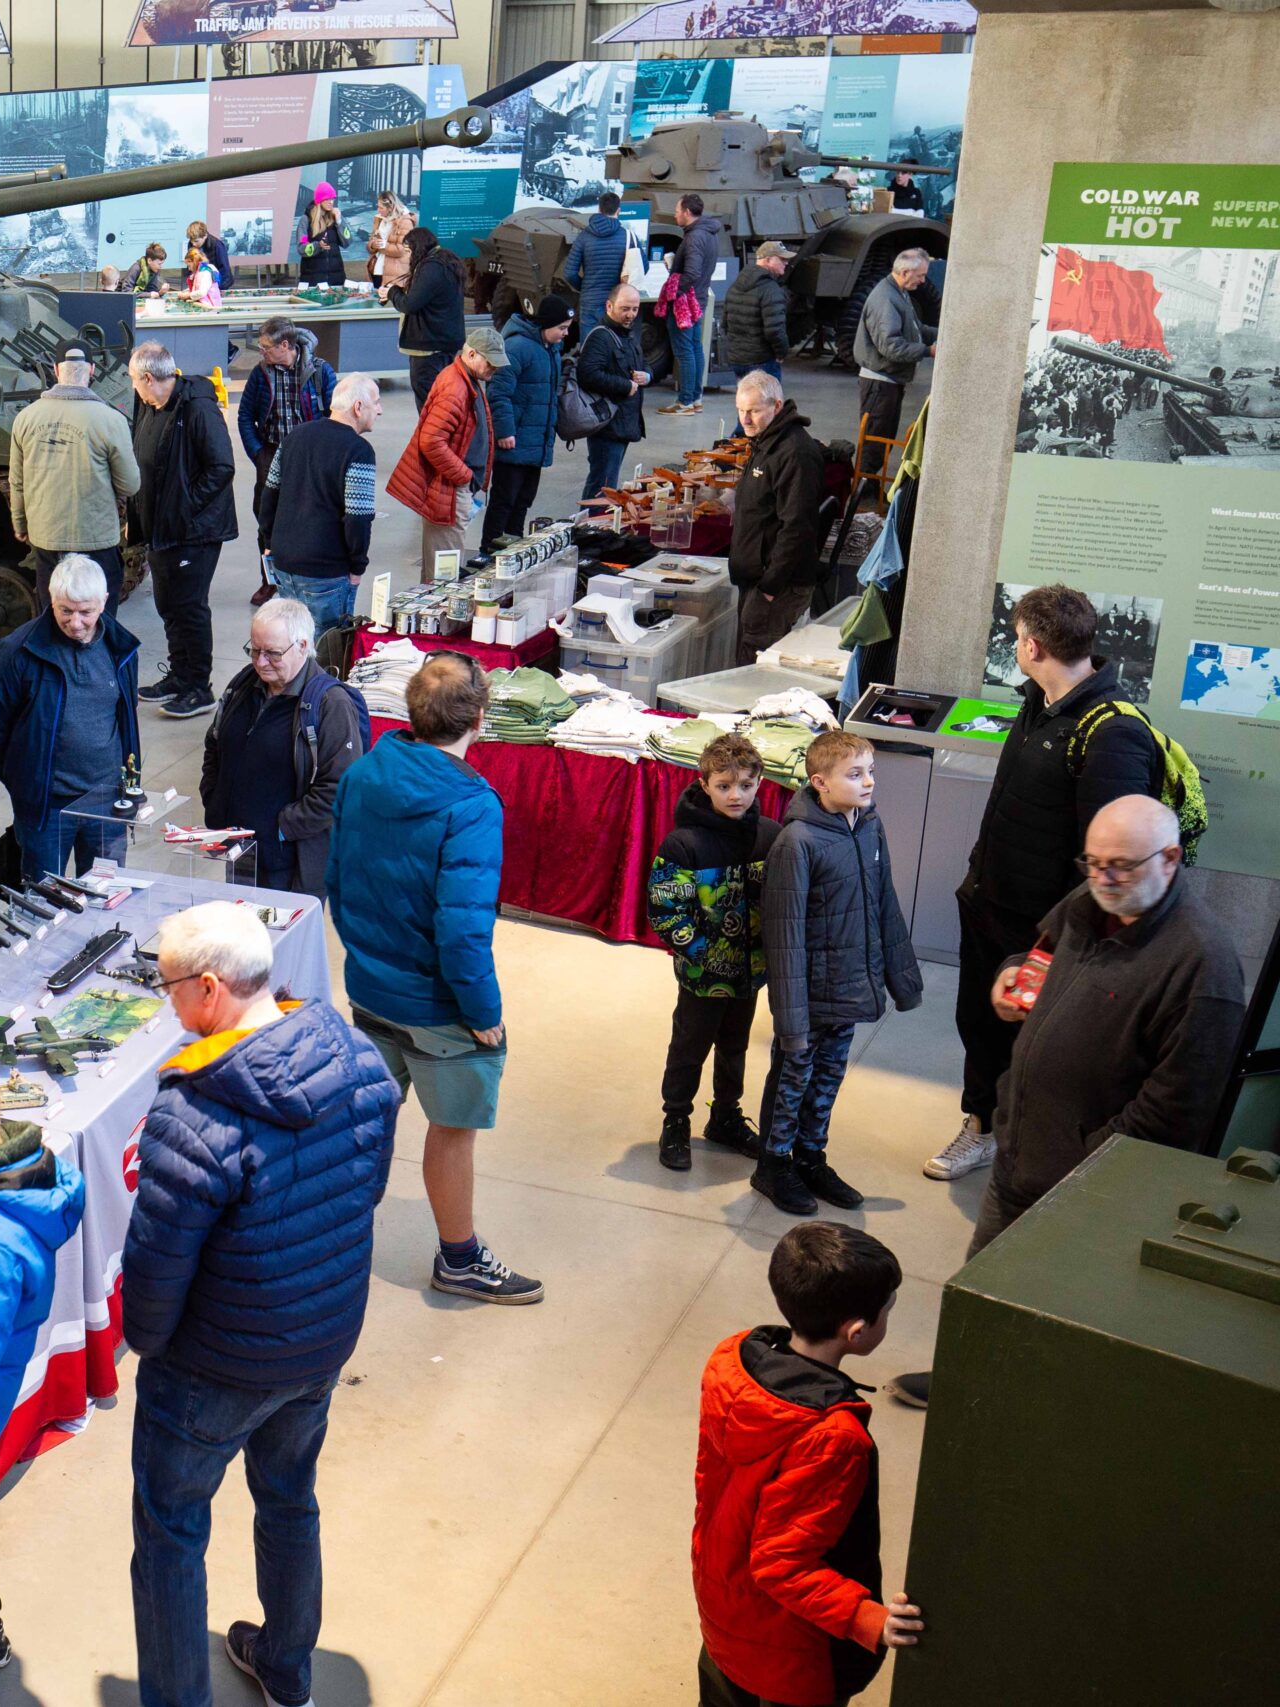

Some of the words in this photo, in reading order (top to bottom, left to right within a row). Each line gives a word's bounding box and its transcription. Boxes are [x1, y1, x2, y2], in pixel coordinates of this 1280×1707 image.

[195, 18, 238, 32] TRAFFIC
[241, 17, 264, 30] JAM
[267, 16, 320, 31] PREVENTS
[324, 15, 350, 29] TANK
[354, 15, 392, 28] RESCUE
[396, 14, 437, 27] MISSION
[1080, 189, 1139, 204] COLD
[1143, 190, 1200, 206] WAR
[1110, 206, 1163, 215] TURNED
[1213, 200, 1280, 212] SUPERP
[1105, 216, 1182, 240] HOT
[1211, 217, 1253, 228] NEW
[1257, 217, 1280, 228] AL
[1211, 507, 1231, 516] West
[1233, 509, 1257, 518] forms
[1198, 583, 1222, 592] East's
[1223, 585, 1241, 593] Pact
[1242, 586, 1252, 594] of
[1252, 587, 1279, 597] Power
